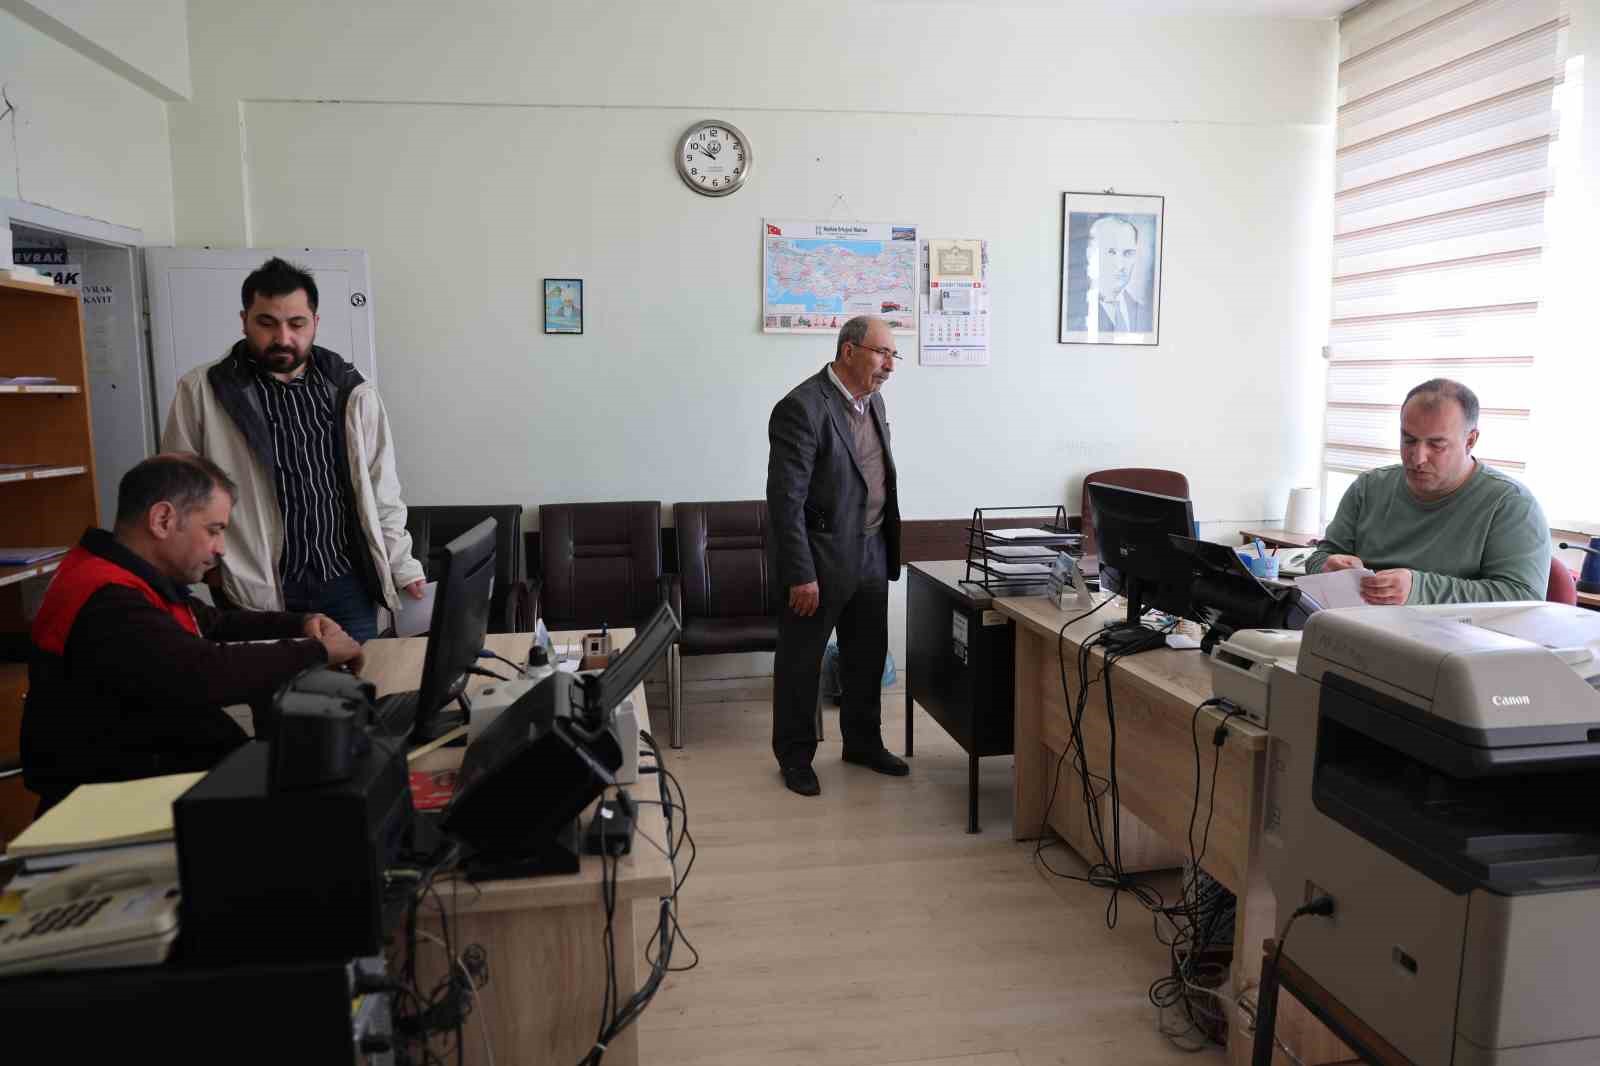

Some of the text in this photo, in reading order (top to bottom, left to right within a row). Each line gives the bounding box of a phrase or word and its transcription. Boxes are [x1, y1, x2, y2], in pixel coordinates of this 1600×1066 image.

[699, 133, 706, 141] 11
[709, 129, 718, 137] 12
[690, 142, 699, 150] 10
[732, 142, 739, 150] 2
[686, 154, 693, 162] 9
[737, 153, 744, 161] 3
[691, 167, 697, 175] 8
[733, 167, 739, 175] 4
[700, 175, 706, 183] 7
[712, 179, 718, 187] 6
[724, 175, 731, 184] 5
[14, 252, 64, 263] EVRAK
[53, 271, 80, 285] AK
[1491, 695, 1530, 706] Canon
